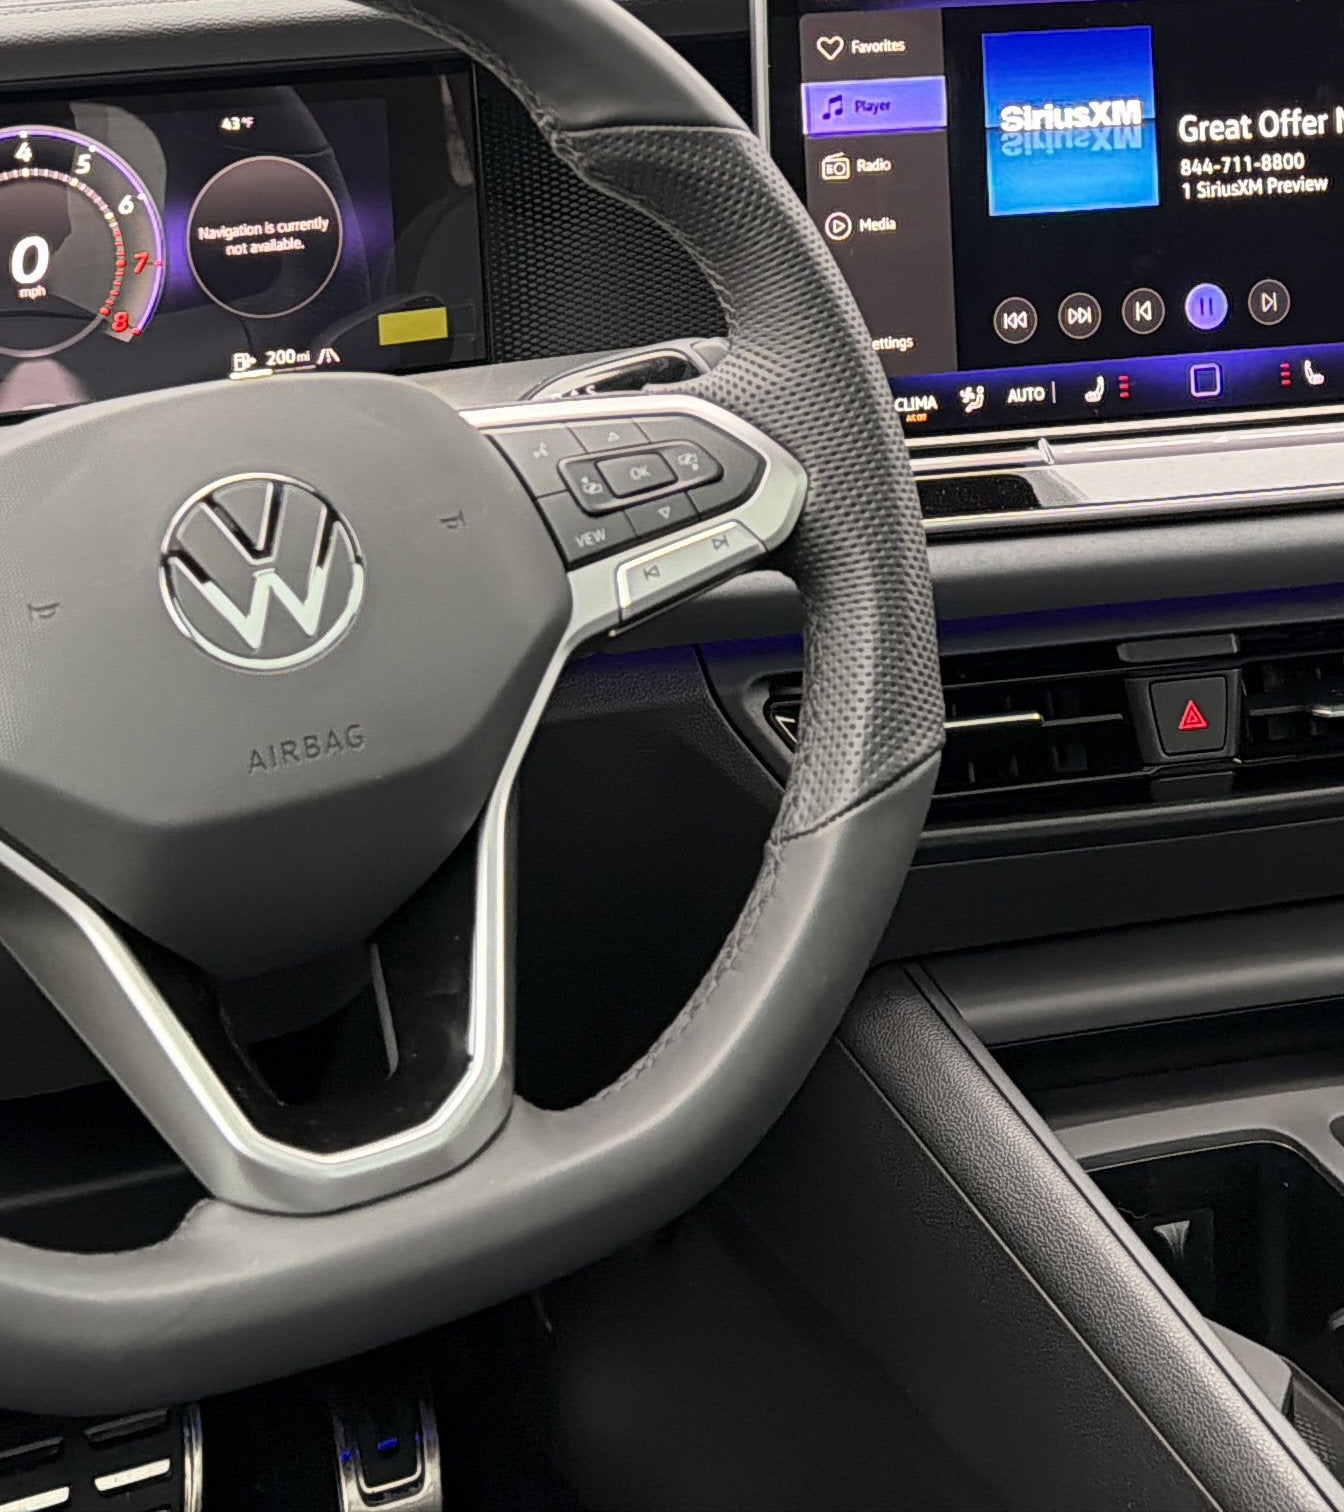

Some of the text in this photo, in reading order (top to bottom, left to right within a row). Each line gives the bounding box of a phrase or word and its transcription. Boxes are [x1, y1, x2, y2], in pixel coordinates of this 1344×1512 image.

[851, 39, 906, 55] Favorites
[854, 99, 891, 116] Player
[1000, 99, 1143, 133] SiriusXM
[1178, 114, 1253, 143] Great
[1257, 107, 1328, 138] Offer
[15, 142, 33, 163] 4
[74, 153, 93, 174] 5
[856, 157, 892, 173] Radio
[1179, 152, 1306, 177] 844-711-8800
[1181, 175, 1329, 200] 1 SiriusXM Preview
[117, 194, 135, 215] 6
[197, 215, 330, 241] Navigation is currently
[859, 216, 897, 232] Media
[225, 236, 305, 256] not available.
[11, 235, 50, 285] 0
[133, 252, 149, 275] 7
[18, 285, 48, 300] mph
[112, 311, 129, 332] 8
[871, 335, 914, 352] ettings
[893, 394, 939, 412] CLIMA
[1007, 386, 1045, 404] AUTO
[629, 464, 651, 480] OK
[574, 528, 606, 548] VIEW
[248, 723, 366, 774] AIRBAG
